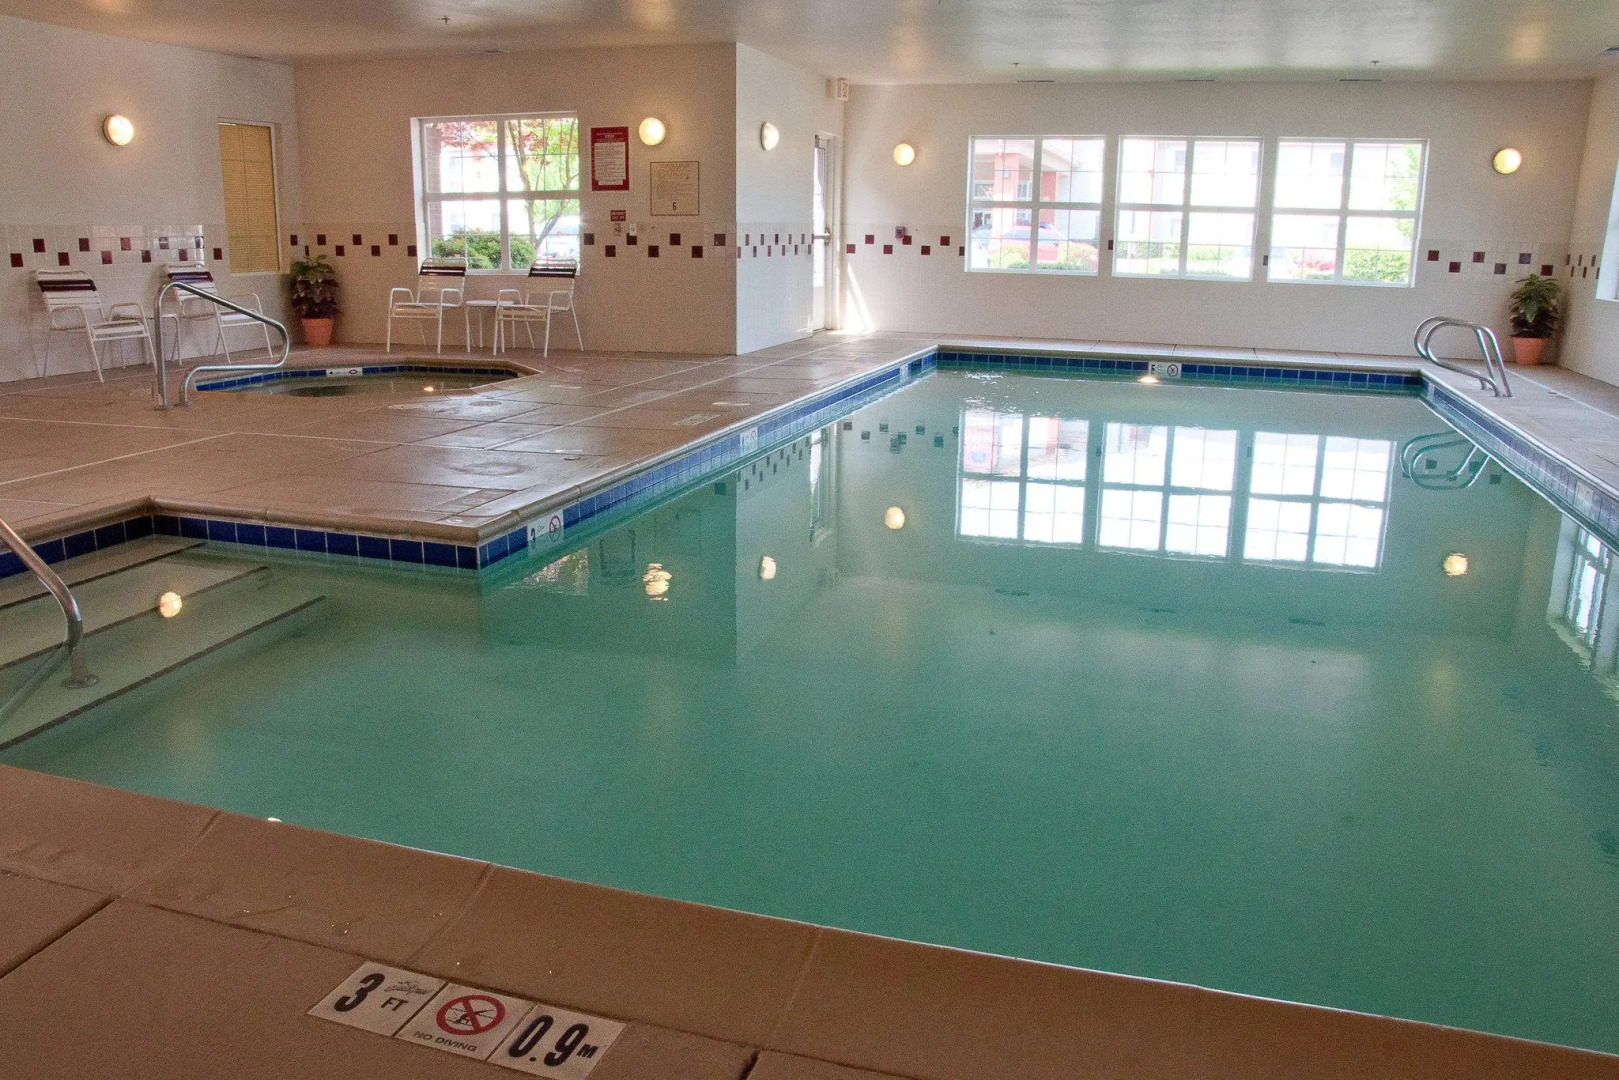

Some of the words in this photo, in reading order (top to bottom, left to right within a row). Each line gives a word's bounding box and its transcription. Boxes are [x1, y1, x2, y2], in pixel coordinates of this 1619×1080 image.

[672, 201, 677, 211] 6
[334, 972, 386, 1012] 3
[381, 996, 409, 1011] FT
[413, 1030, 433, 1041] NO
[434, 1036, 478, 1052] DIVING
[508, 1014, 589, 1067] 0.9
